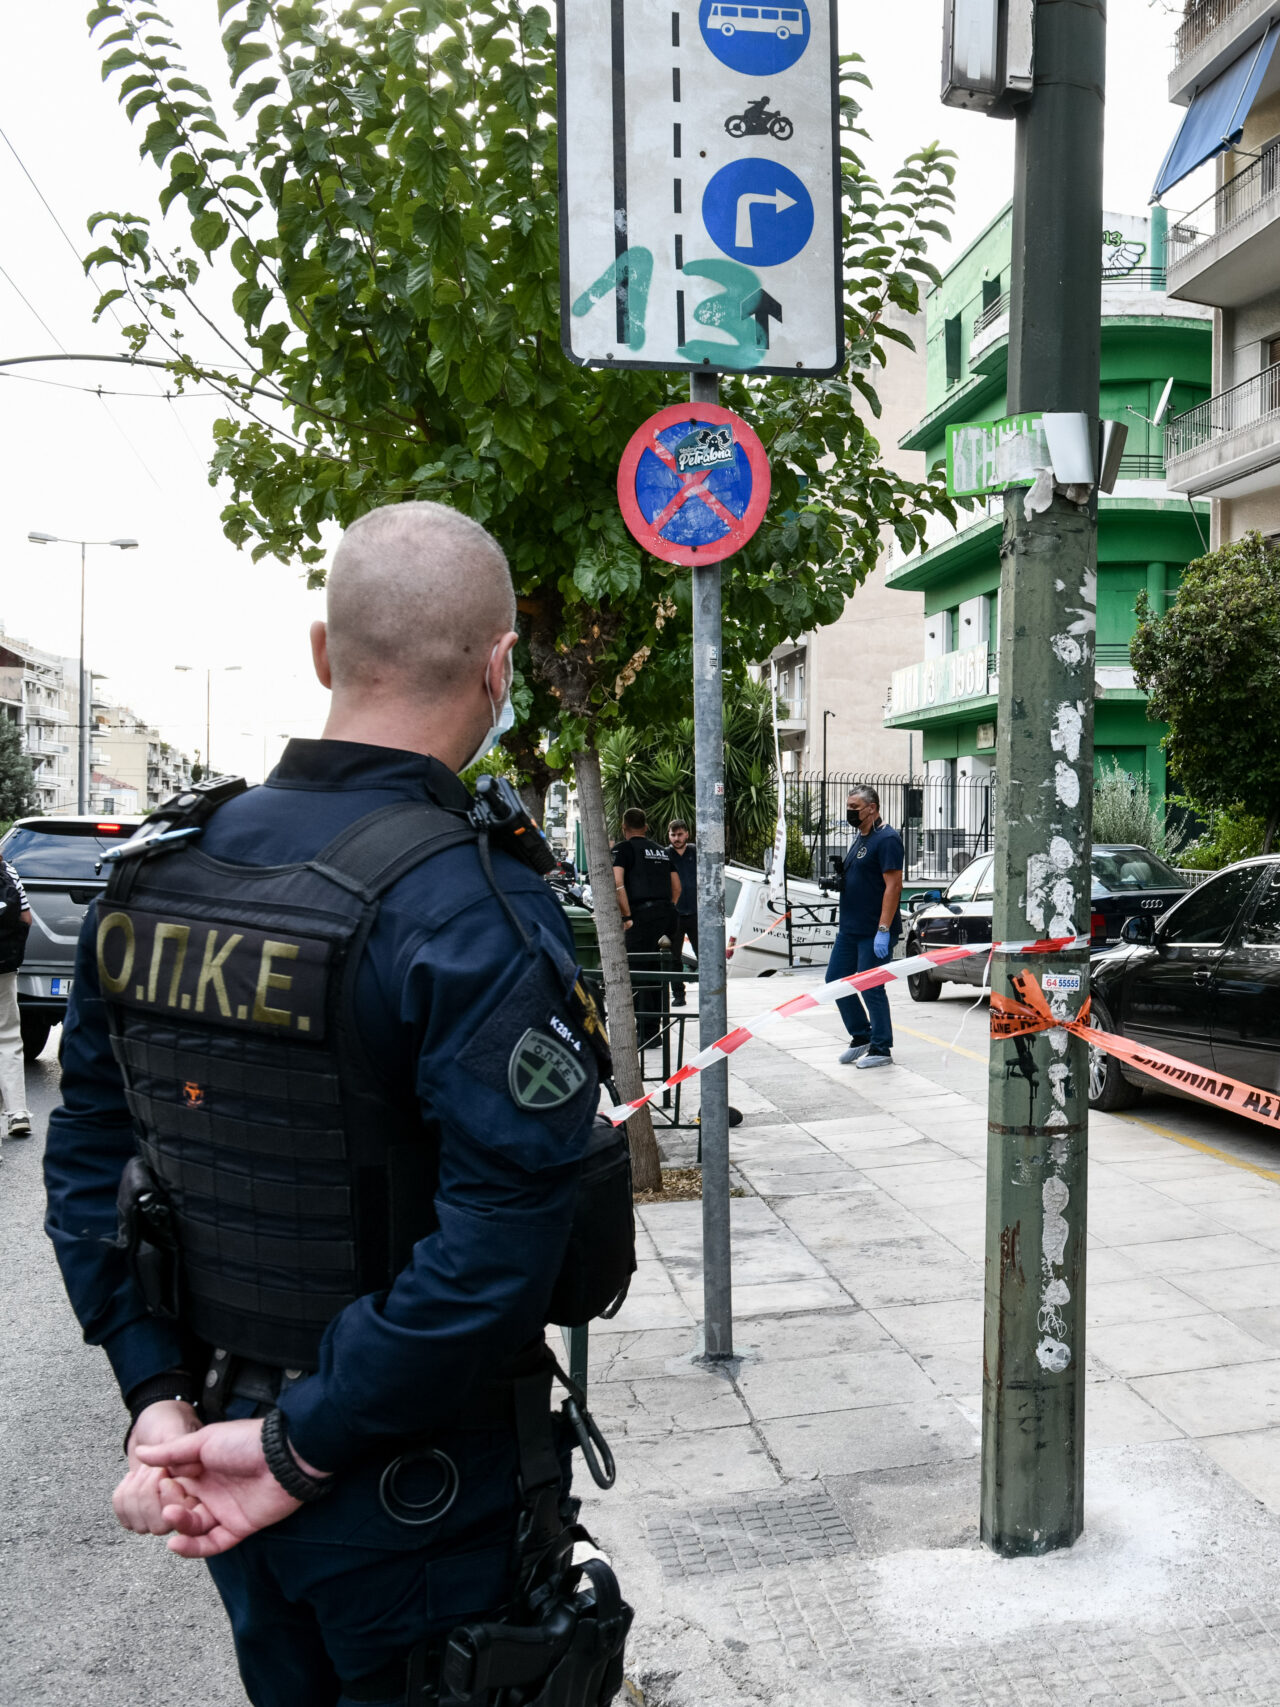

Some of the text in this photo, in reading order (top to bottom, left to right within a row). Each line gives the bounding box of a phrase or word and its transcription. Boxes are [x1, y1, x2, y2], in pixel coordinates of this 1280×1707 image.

[1102, 230, 1122, 247] 13
[572, 246, 766, 370] 13
[679, 446, 732, 471] Petralona
[96, 911, 311, 1032] Ο.Π.Κ.Ε.
[1046, 978, 1079, 988] 64 55555
